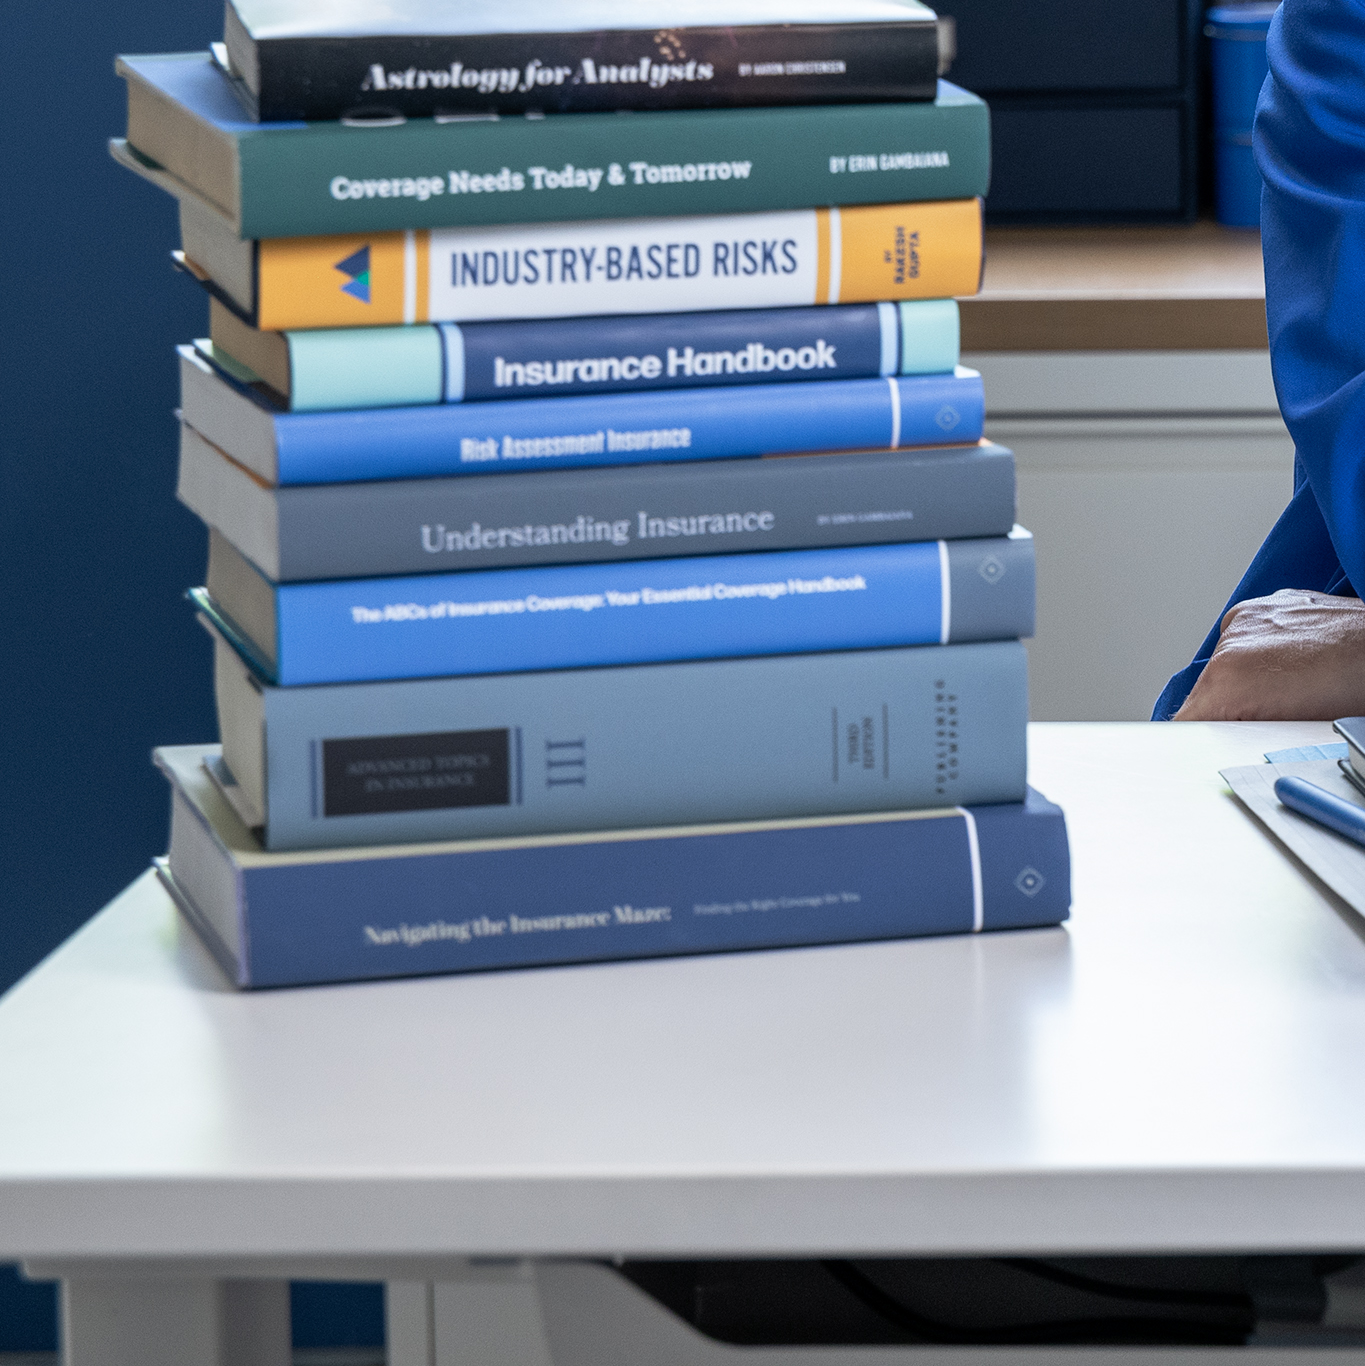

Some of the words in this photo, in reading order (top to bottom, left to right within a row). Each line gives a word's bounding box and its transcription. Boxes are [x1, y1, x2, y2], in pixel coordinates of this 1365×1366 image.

[361, 61, 520, 94] Astrology
[517, 58, 571, 93] for
[572, 56, 715, 89] Analysts
[738, 62, 752, 77] BY
[330, 174, 446, 201] Coverage
[447, 167, 526, 195] Needs
[528, 164, 603, 192] Today
[606, 162, 626, 186] &
[629, 159, 753, 186] Tomorrow
[829, 155, 847, 174] BY
[848, 154, 878, 173] ERIN
[451, 243, 700, 288] INDUSTRY-BASED
[713, 238, 798, 278] RISKS
[894, 226, 905, 284] RAKESH
[909, 231, 920, 279] GUPTA
[494, 354, 662, 387] Insurance
[666, 339, 837, 378] Handbook
[460, 437, 499, 462] Risk
[502, 431, 605, 460] Assessment
[607, 427, 691, 453] Insurance
[421, 515, 631, 554] Understanding
[637, 510, 775, 540] Insurance
[352, 605, 383, 623] The
[384, 602, 429, 621] ABCs
[430, 600, 447, 619] of
[448, 599, 525, 617] Insurance
[605, 589, 639, 606] Your
[641, 585, 713, 604] Essential
[714, 582, 787, 600] Coverage
[788, 575, 867, 594] Handbook
[847, 722, 859, 764] THIRD
[862, 717, 875, 770] EDITION
[935, 679, 947, 794] PUBLISHING
[365, 919, 472, 947] Navigating
[473, 915, 506, 936] the
[509, 911, 610, 933] Insurance
[613, 904, 672, 925] Maze:
